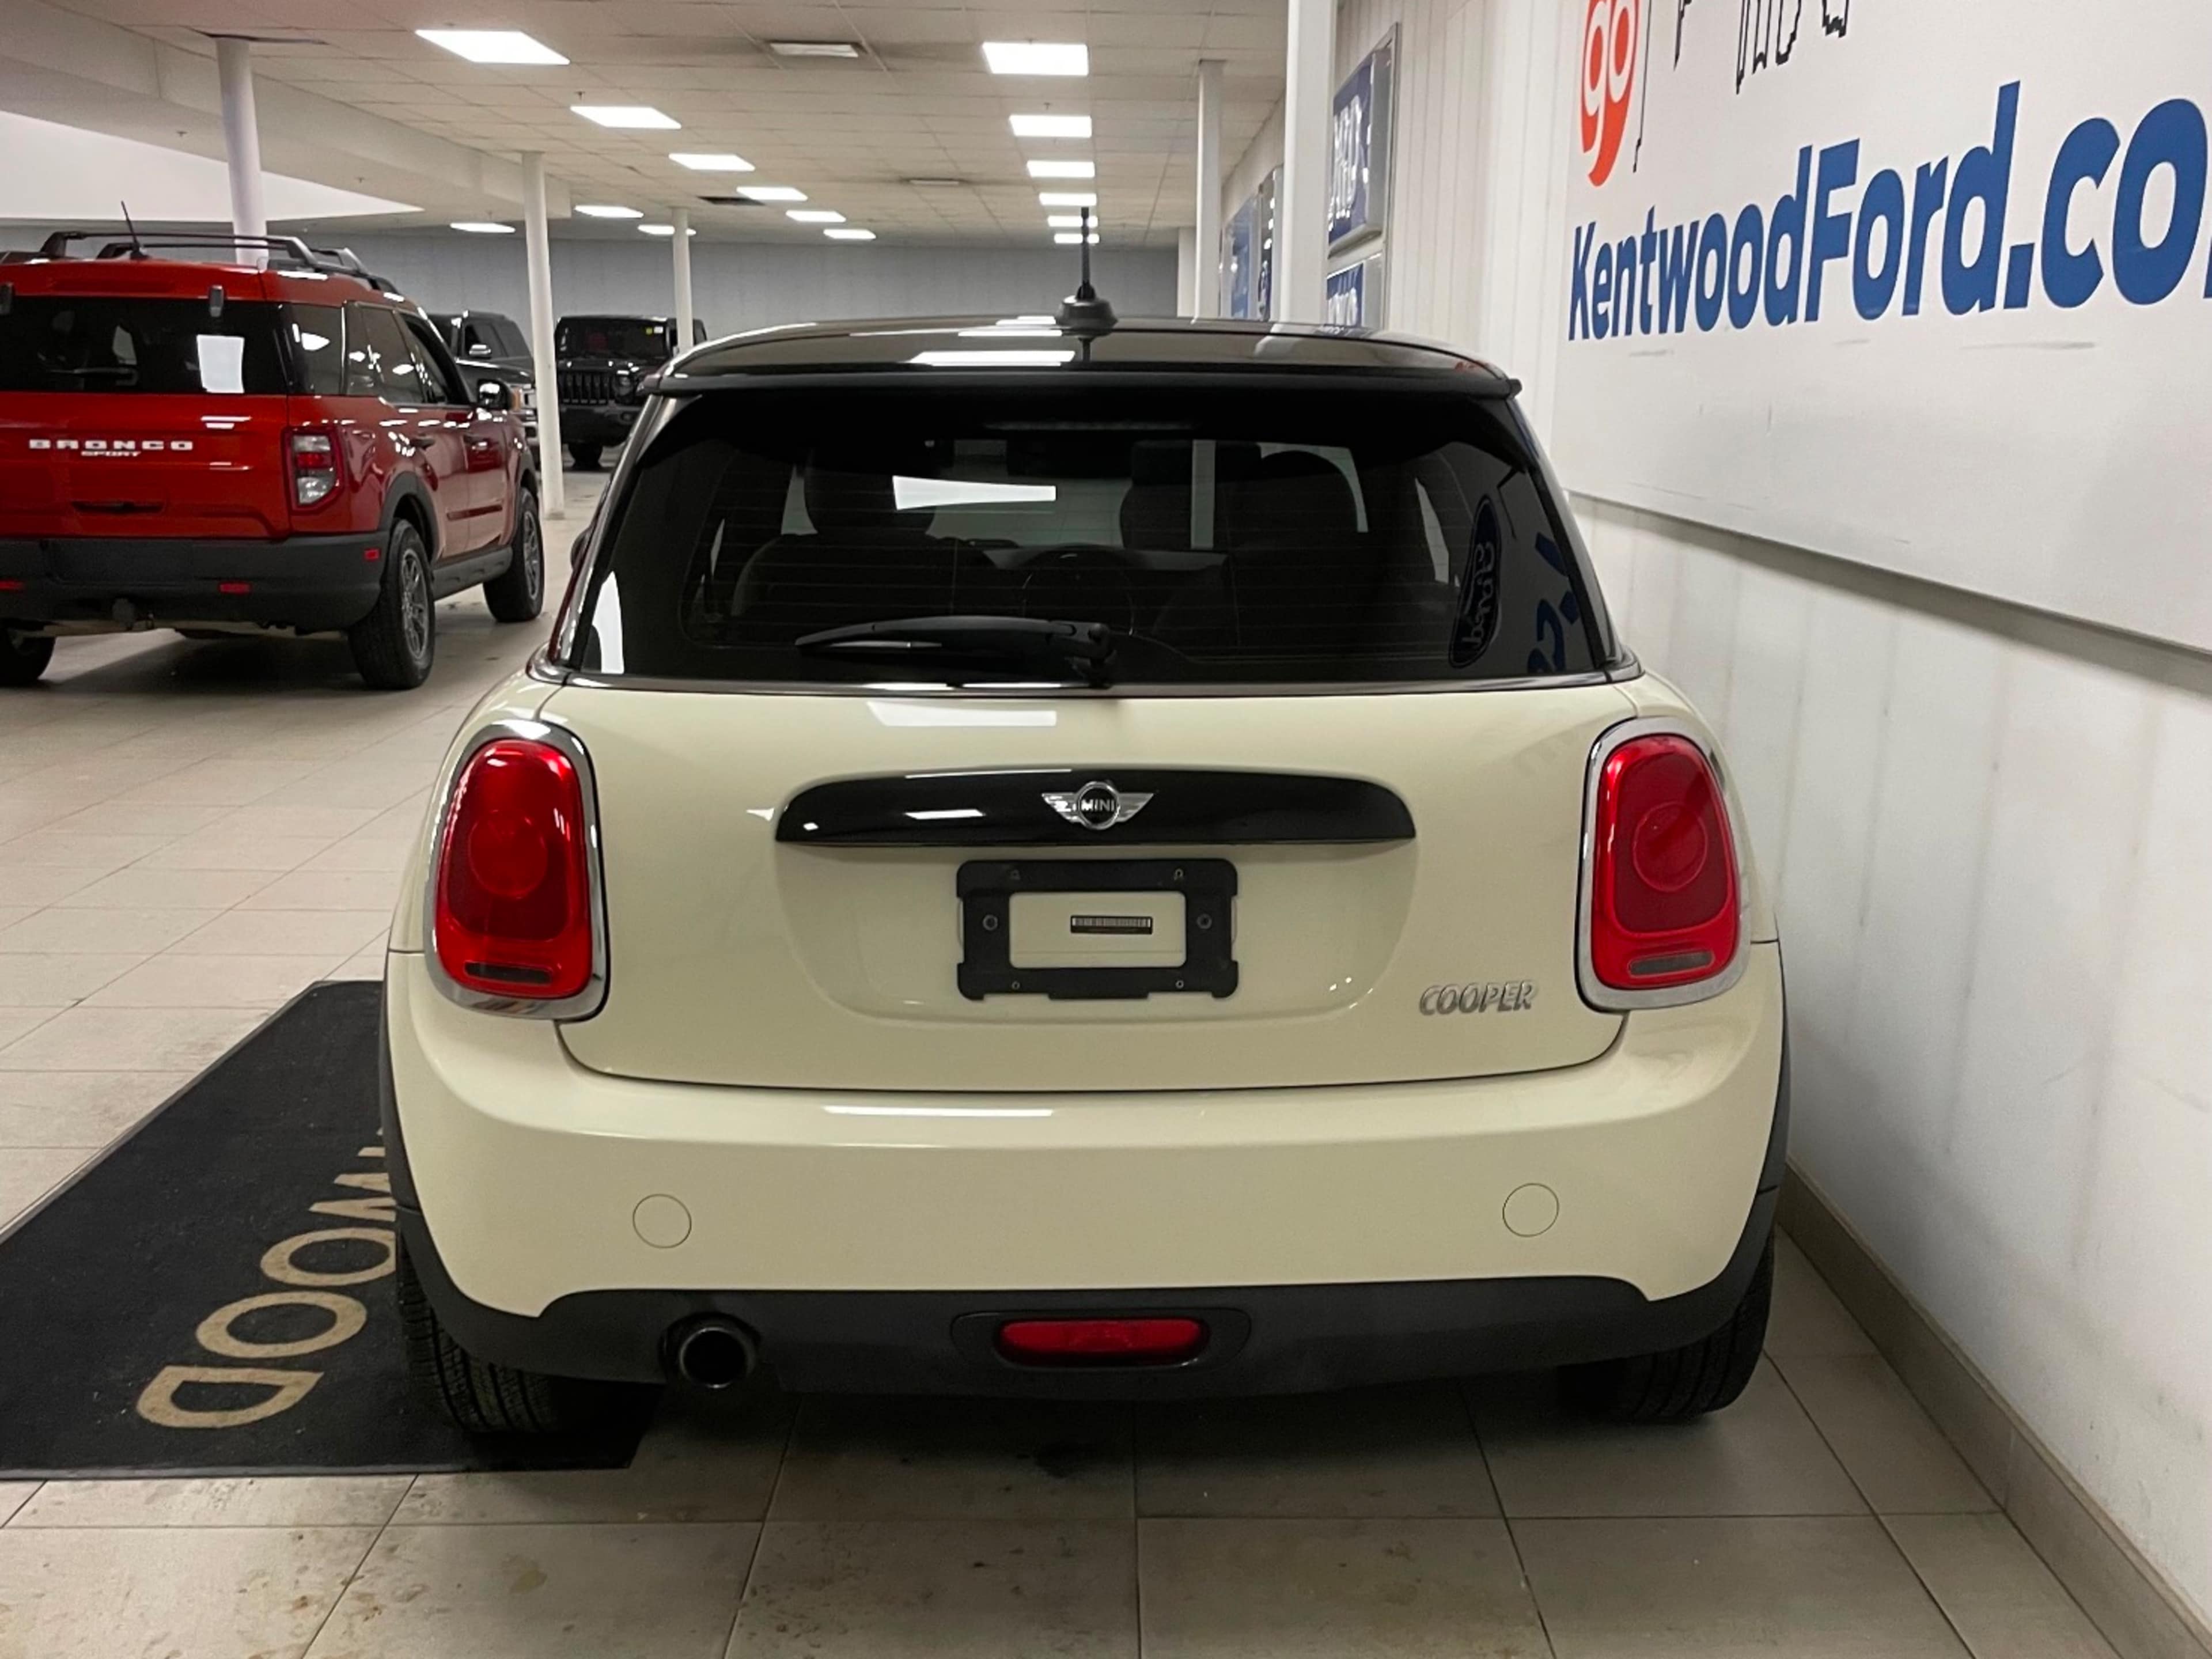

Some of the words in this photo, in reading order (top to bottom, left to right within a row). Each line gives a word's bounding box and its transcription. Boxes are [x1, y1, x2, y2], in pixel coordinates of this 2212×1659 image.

[1569, 80, 2212, 341] KentwoodFord.co
[29, 439, 194, 451] BRONCO
[1081, 798, 1115, 812] MINI
[1419, 979, 1538, 1016] COOPER
[137, 1128, 396, 1428] WOOD
